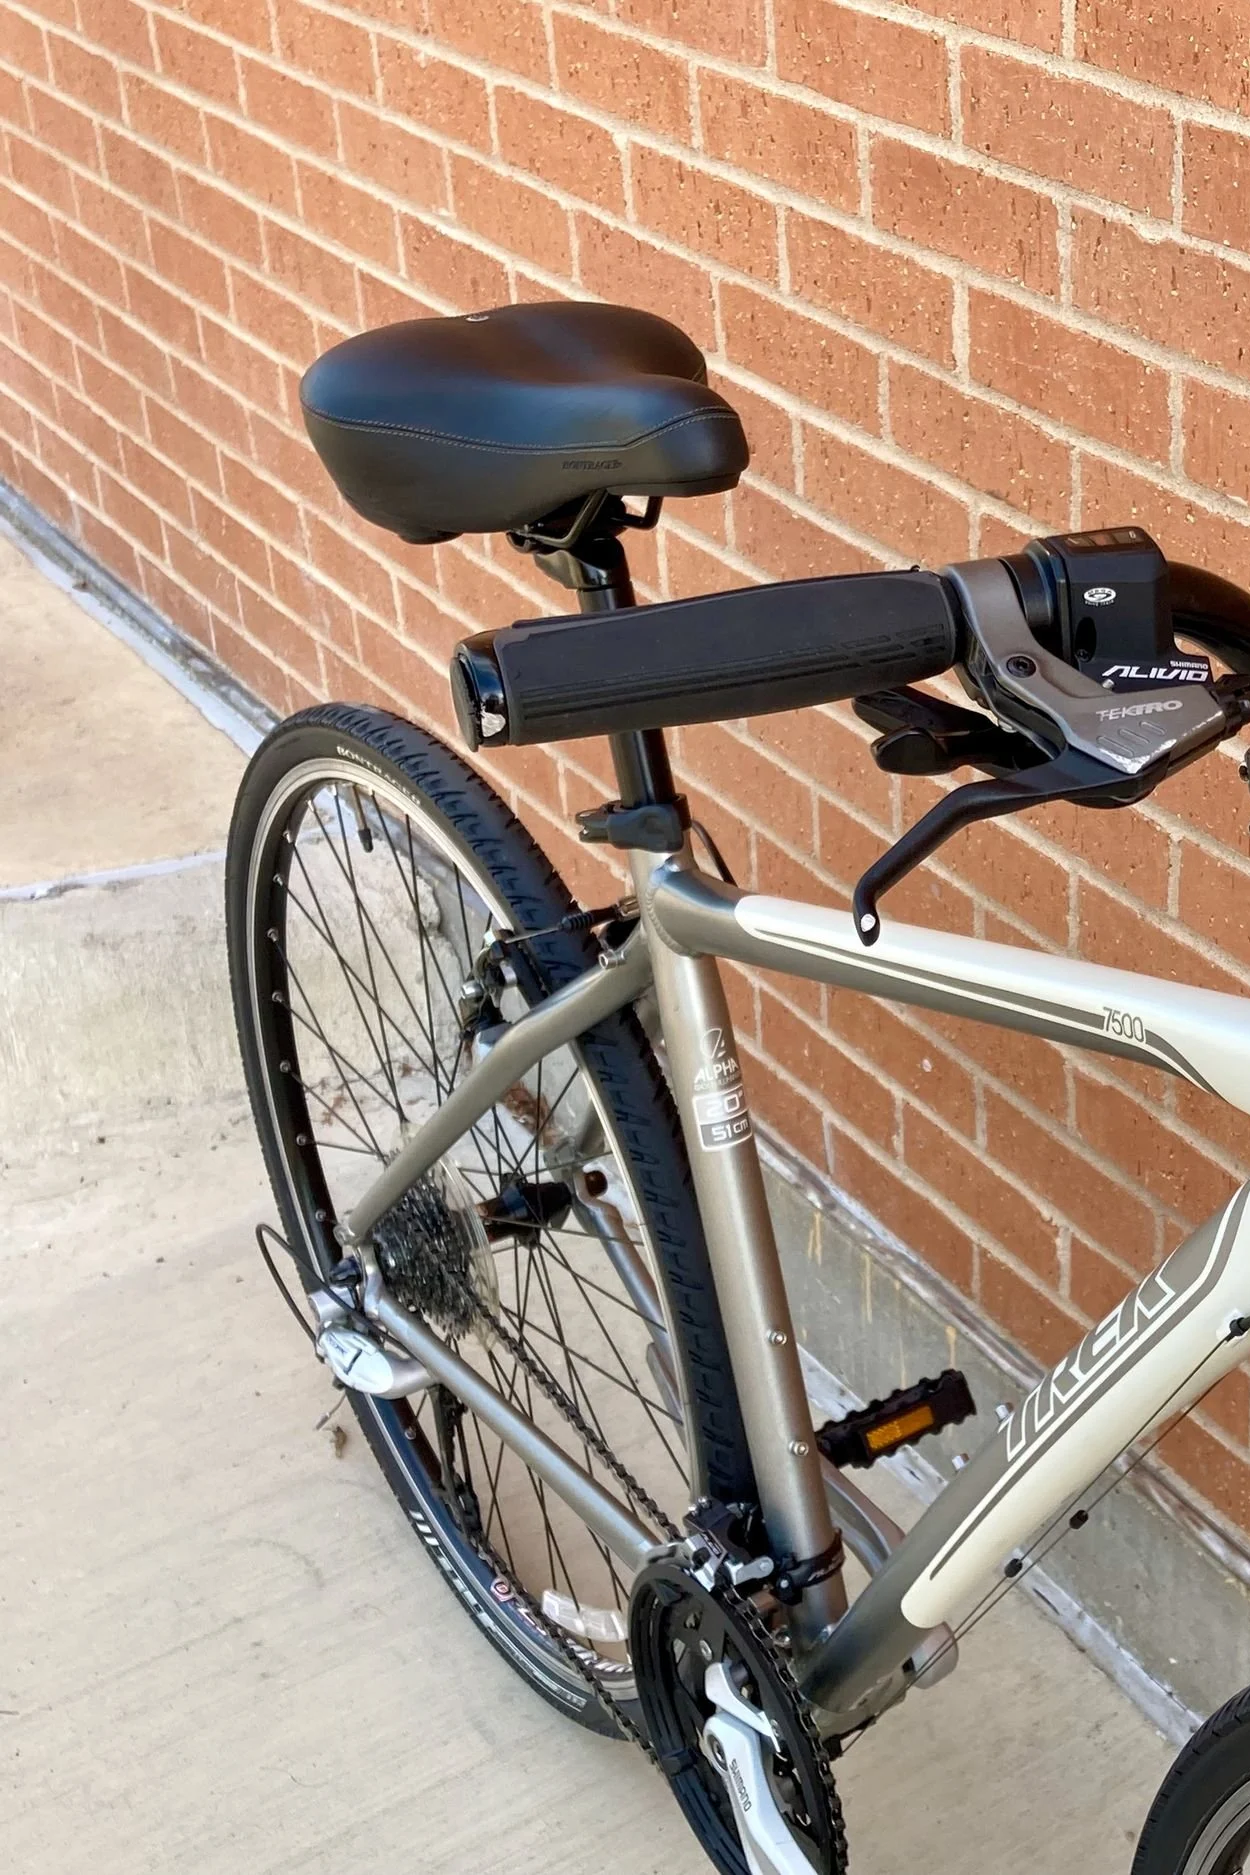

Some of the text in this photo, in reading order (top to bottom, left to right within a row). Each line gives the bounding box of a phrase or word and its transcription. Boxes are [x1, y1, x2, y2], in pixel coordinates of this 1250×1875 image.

[1102, 665, 1209, 682] ALIVIO
[1096, 700, 1183, 721] TEKTRO
[1102, 1006, 1145, 1043] 7500
[694, 1058, 740, 1084] ALPHA
[998, 1246, 1178, 1463] TREK
[729, 1758, 752, 1812] SHIMANO
